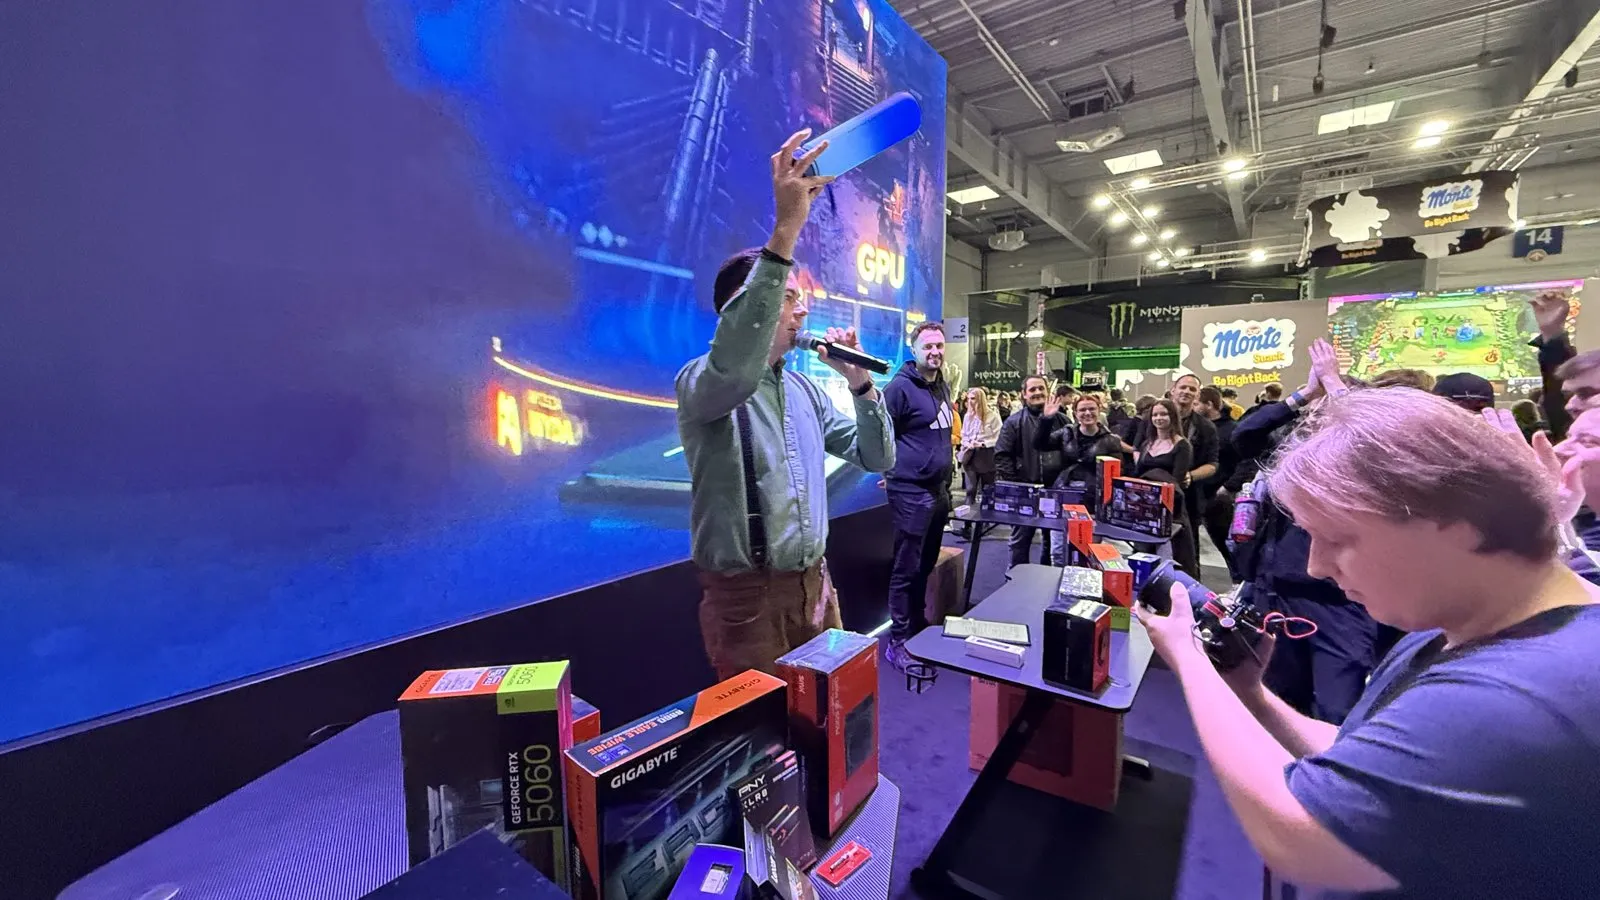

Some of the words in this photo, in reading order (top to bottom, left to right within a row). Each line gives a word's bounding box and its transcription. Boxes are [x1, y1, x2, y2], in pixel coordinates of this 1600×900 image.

[1427, 185, 1473, 208] Monte
[1525, 229, 1552, 246] 14
[857, 243, 905, 289] GPU
[960, 324, 966, 332] 2
[1212, 326, 1281, 358] Monte
[974, 370, 1020, 379] MONSTER
[1213, 376, 1226, 386] Be
[1226, 374, 1254, 388] Right
[1254, 371, 1281, 383] Back
[715, 678, 761, 700] GIGABYTE
[509, 752, 519, 774] RTX
[610, 748, 678, 789] GIGABYTE
[524, 744, 554, 822] 5060
[739, 774, 765, 797] PNY
[510, 775, 521, 824] GEFORCE
